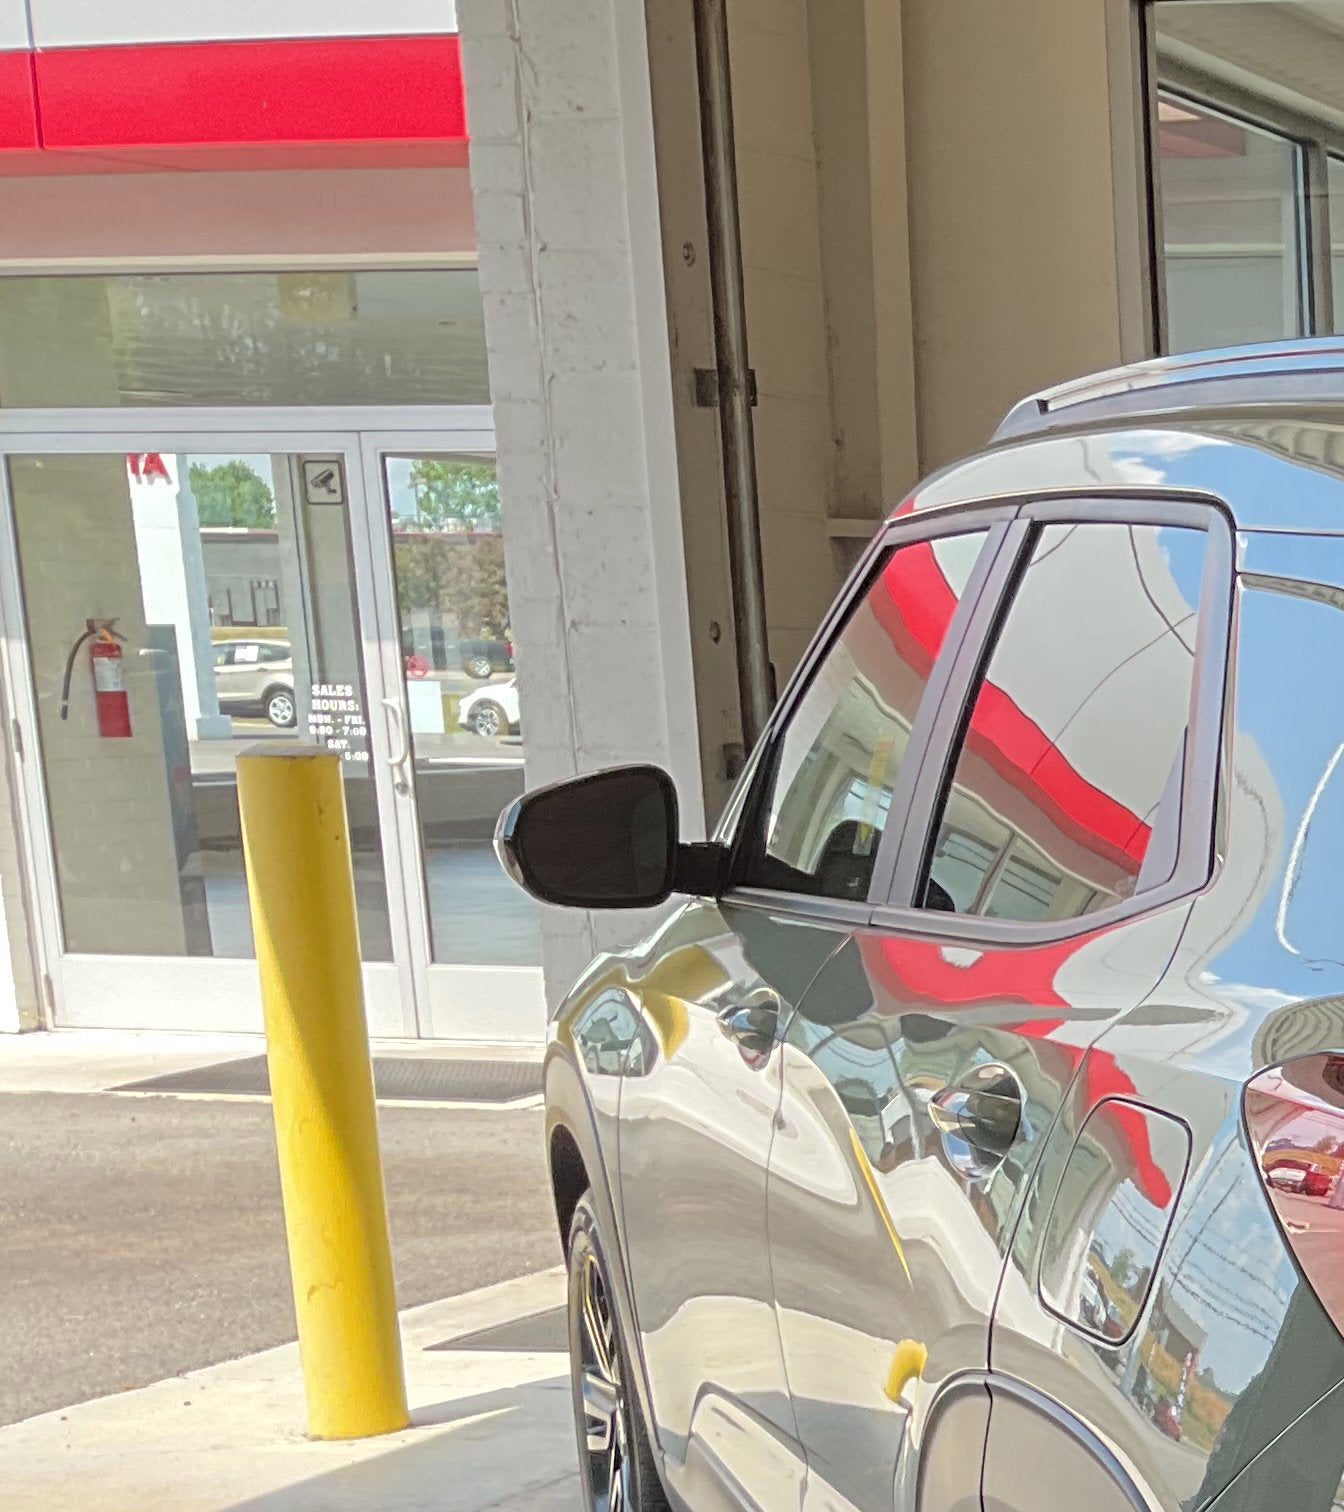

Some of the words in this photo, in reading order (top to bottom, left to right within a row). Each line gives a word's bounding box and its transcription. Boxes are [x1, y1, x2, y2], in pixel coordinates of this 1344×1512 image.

[311, 684, 353, 697] SALES
[311, 699, 359, 711] HOURS:
[307, 714, 335, 724] MON.
[344, 715, 366, 725] FRI.
[342, 726, 367, 736] 7:00
